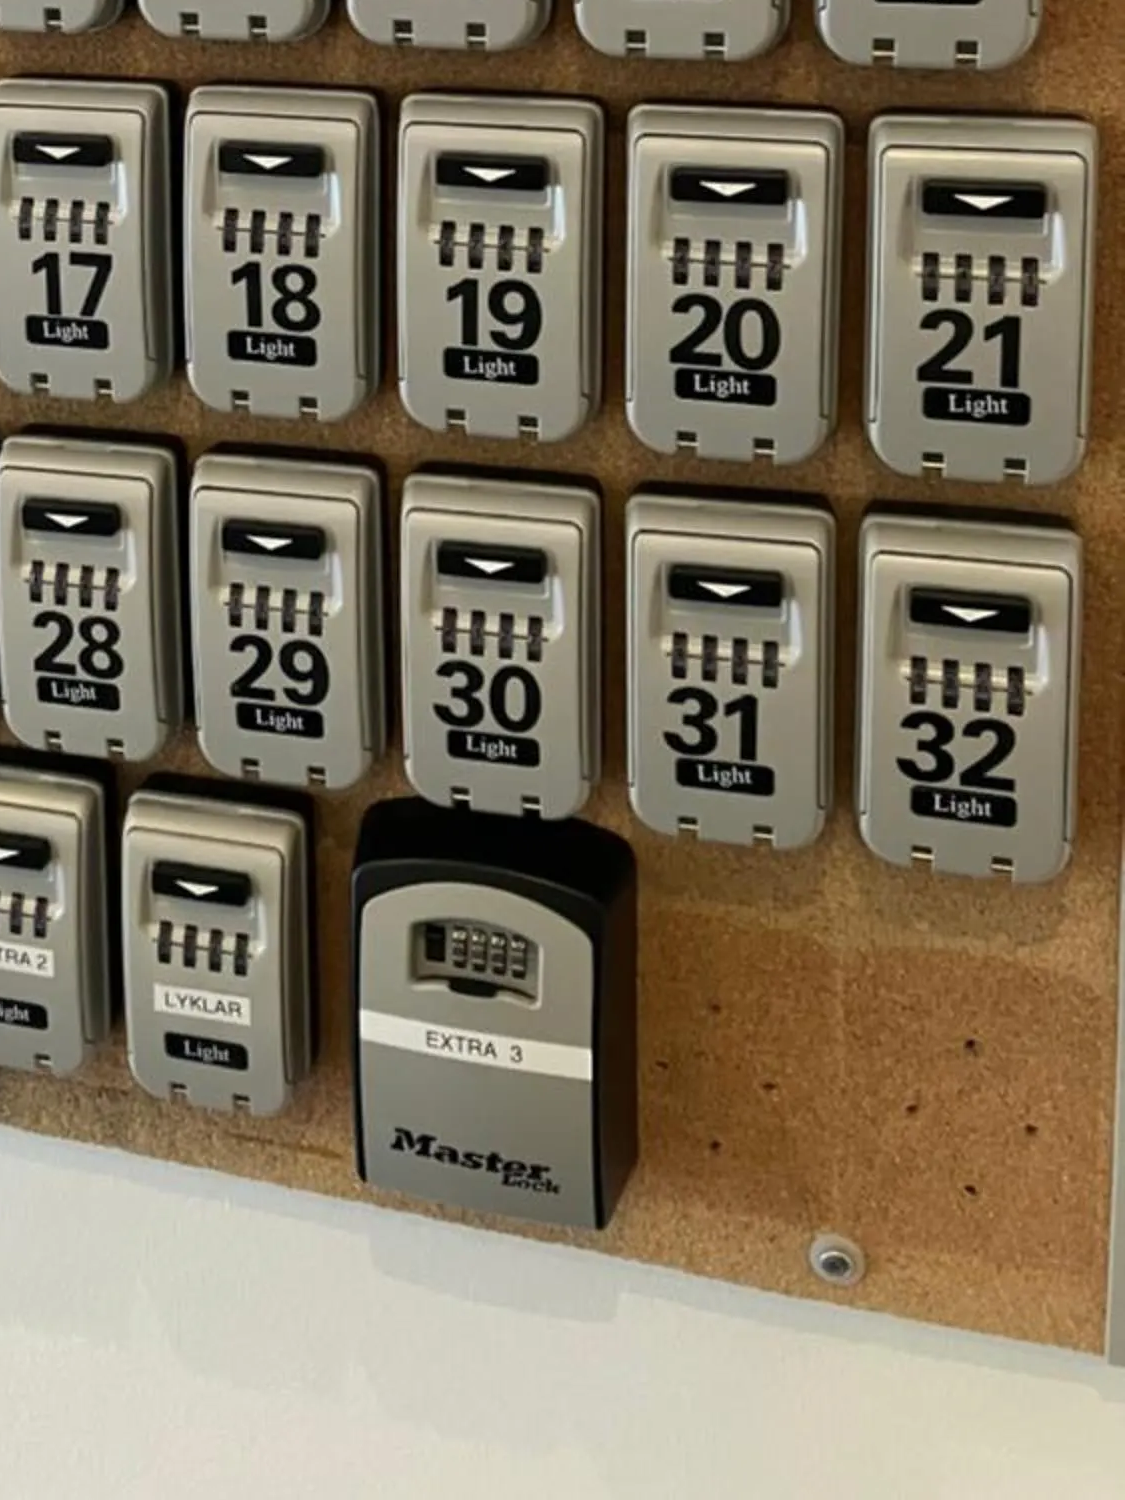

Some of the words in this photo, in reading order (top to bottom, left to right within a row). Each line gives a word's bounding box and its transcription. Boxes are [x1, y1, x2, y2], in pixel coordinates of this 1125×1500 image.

[31, 252, 113, 318] 17
[231, 262, 321, 332] 18
[447, 278, 541, 350] 19
[42, 321, 90, 342] Light
[669, 293, 781, 372] 20
[245, 338, 297, 360] Light
[917, 309, 1021, 388] 21
[463, 356, 517, 378] Light
[694, 373, 751, 397] Light
[949, 394, 1009, 416] Light
[33, 611, 124, 680] 28
[230, 635, 330, 705] 29
[51, 682, 97, 701] Light
[433, 660, 541, 732] 30
[256, 709, 305, 730] Light
[663, 687, 759, 761] 31
[466, 736, 517, 758] Light
[896, 711, 1017, 793] 32
[697, 764, 752, 786] Light
[934, 796, 992, 818] Light
[36, 955, 47, 970] 2
[164, 994, 242, 1017] LYKLAR
[184, 1039, 230, 1061] Light
[426, 1030, 497, 1058] EXTRA
[510, 1046, 523, 1063] 3
[391, 1128, 551, 1180] Master
